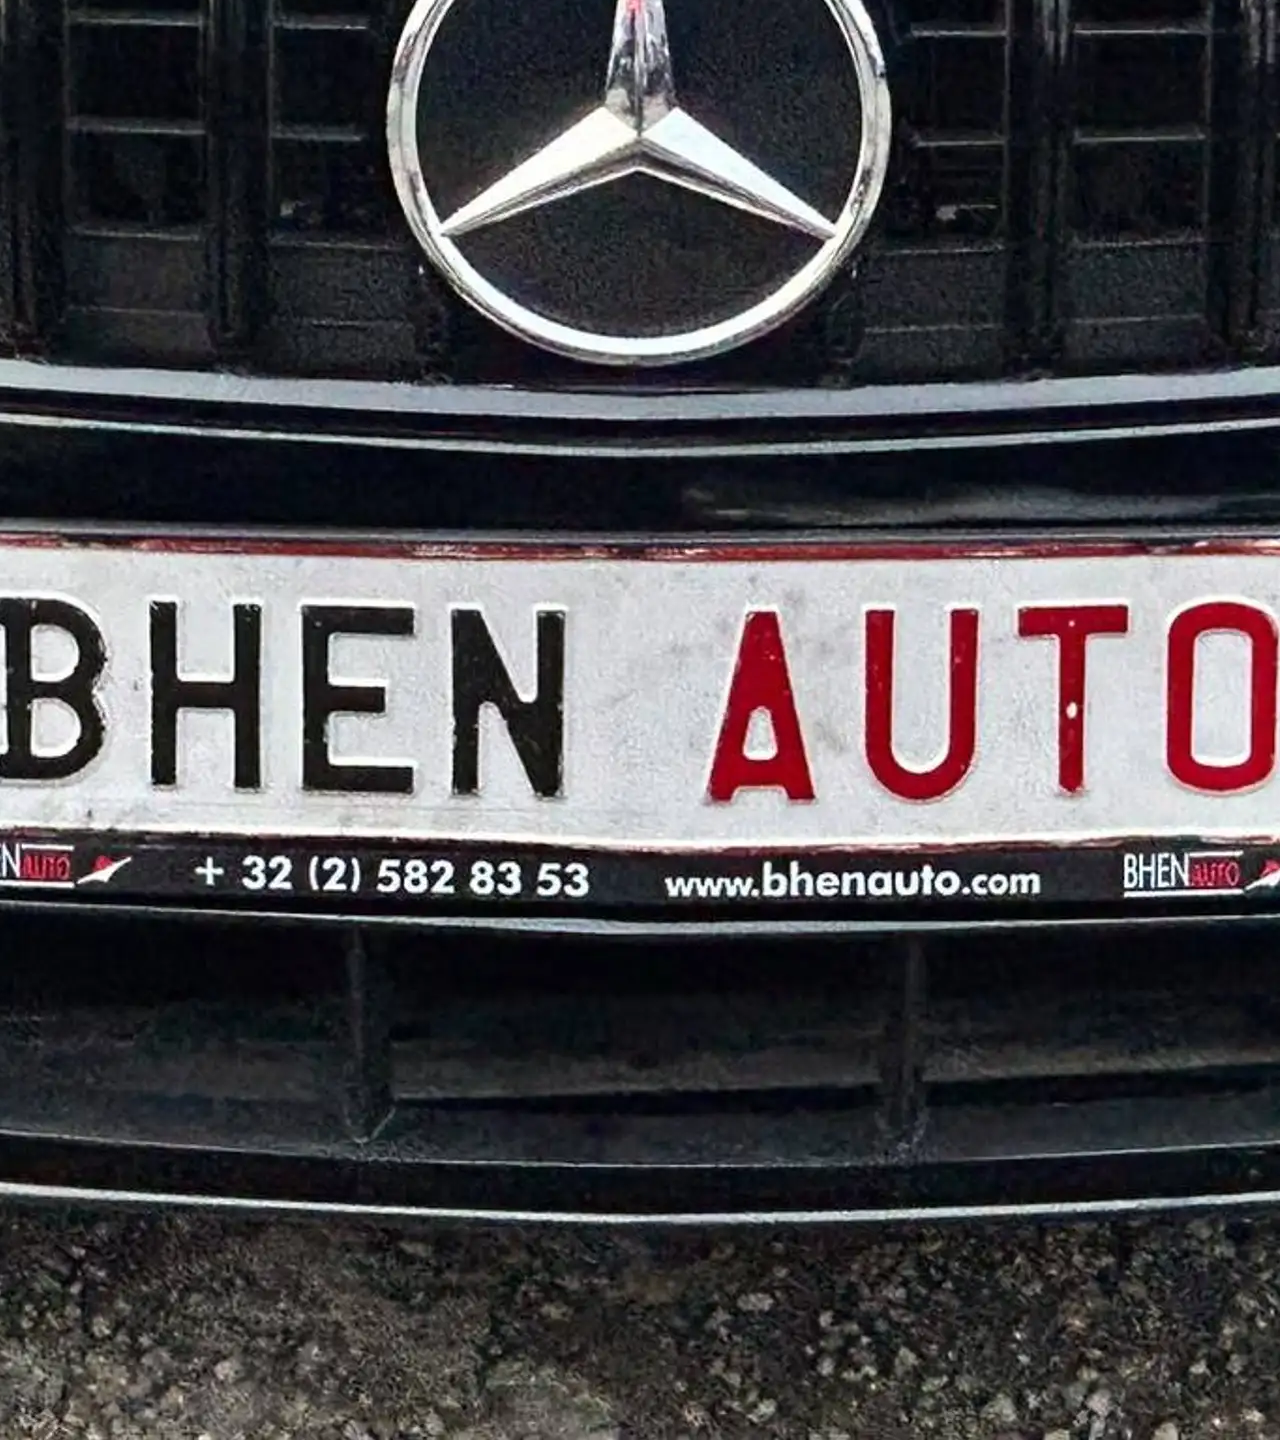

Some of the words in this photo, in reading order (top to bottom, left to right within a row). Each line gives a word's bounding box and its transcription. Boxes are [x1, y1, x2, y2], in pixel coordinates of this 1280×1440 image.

[709, 601, 1280, 803] AUTO
[242, 855, 292, 890] 32
[309, 856, 360, 892] (2)
[377, 859, 454, 894] 582
[469, 860, 521, 895] 83
[537, 862, 589, 897] 53
[663, 861, 1040, 897] www.bhenauto.com
[1123, 852, 1189, 889] BHEN
